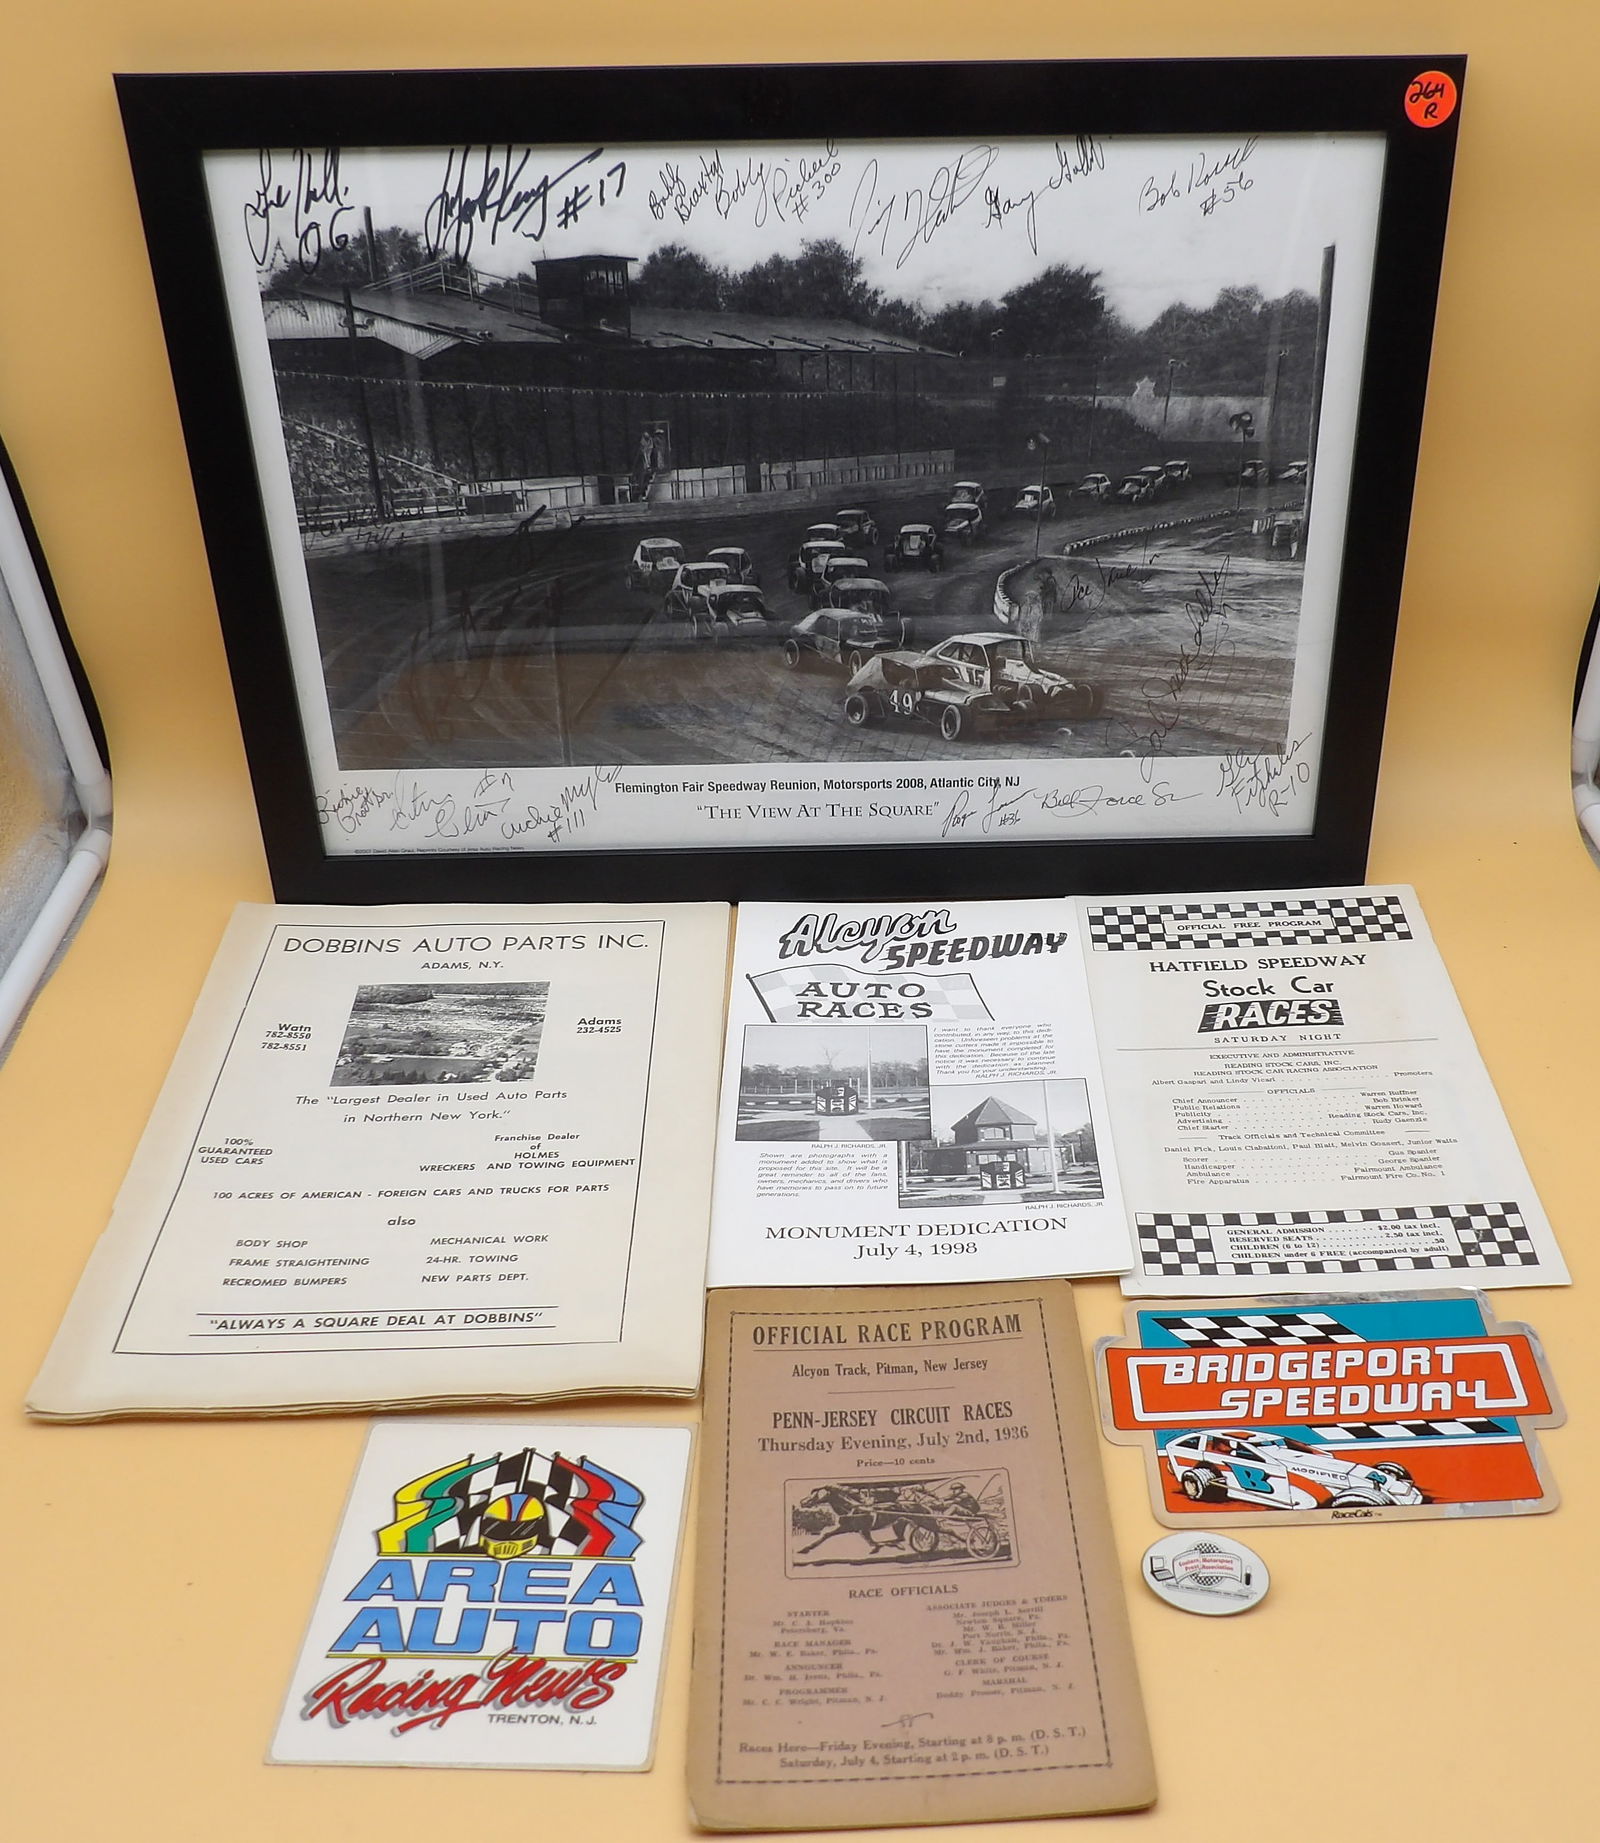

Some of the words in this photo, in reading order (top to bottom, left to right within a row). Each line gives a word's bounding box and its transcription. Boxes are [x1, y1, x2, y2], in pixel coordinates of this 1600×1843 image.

[1409, 80, 1445, 103] 264
[1424, 102, 1438, 119] R
[888, 688, 915, 715] 49
[616, 783, 678, 795] Flemington
[683, 782, 704, 792] Fair
[708, 781, 766, 793] Speedway
[771, 780, 819, 791] Reunion,
[824, 779, 892, 791] Motorsports
[896, 778, 926, 789] 2008,
[930, 777, 973, 788] Atlantic
[1006, 776, 1019, 786] NJ
[284, 938, 401, 953] DOBBINS
[413, 937, 491, 952] AUTO
[503, 936, 586, 950] PARTS
[599, 935, 647, 948] INC.
[778, 908, 959, 964] Alcyon
[878, 931, 1069, 972] SPEEDWAY
[421, 962, 471, 970] ADAMS,
[1150, 960, 1247, 972] HATFIELD
[1258, 954, 1366, 969] SPEEDWAY
[795, 981, 926, 999] AUTO
[1203, 978, 1275, 997] Stock
[1291, 976, 1333, 993] Car
[797, 1001, 935, 1020] RACES
[1213, 1000, 1334, 1031] RACES
[578, 1017, 621, 1025] Adams
[266, 1031, 311, 1039] 782-8550
[1215, 1036, 1286, 1046] SATURDAY
[262, 1042, 306, 1051] 782-8551
[296, 1096, 318, 1104] The
[388, 1094, 430, 1103] Dealer
[457, 1092, 488, 1101] Used
[364, 1113, 422, 1122] Northern
[431, 1112, 461, 1120] New
[198, 1147, 272, 1155] GUARANTEED
[572, 1159, 635, 1167] EQUIPMENT
[302, 1191, 362, 1199] AMERICAN
[576, 1184, 609, 1192] PARTS
[388, 1216, 415, 1225] also
[766, 1225, 910, 1239] MONUMENT
[918, 1218, 1066, 1236] DEDICATION
[430, 1237, 505, 1245] MECHANICAL
[854, 1243, 898, 1260] July
[905, 1244, 922, 1257] 4,
[931, 1243, 977, 1255] 1998
[276, 1258, 369, 1267] STRAIGHTENING
[294, 1277, 347, 1285] BUMPERS
[456, 1274, 491, 1282] PARTS
[293, 1319, 304, 1328] A
[314, 1317, 379, 1327] SQUARE
[387, 1315, 425, 1325] DEAL
[434, 1315, 456, 1324] AT
[753, 1325, 847, 1345] OFFICIAL
[858, 1323, 911, 1343] RACE
[921, 1314, 1022, 1345] PROGRAM
[792, 1364, 829, 1379] Alcyon
[835, 1363, 870, 1376] Track,
[877, 1362, 918, 1375] Pitman,
[924, 1360, 947, 1372] New
[953, 1358, 987, 1370] Jersey
[1163, 1346, 1454, 1386] BRIDGEPORT
[1220, 1380, 1486, 1419] SPEEDWAY
[773, 1410, 877, 1428] PENN-JERSEY
[891, 1406, 950, 1425] CIRCUIT
[963, 1401, 1012, 1421] RACES
[758, 1437, 834, 1453] Thursday
[841, 1435, 911, 1449] Evening,
[917, 1432, 949, 1448] July
[956, 1429, 989, 1444] 2nd,
[995, 1426, 1028, 1441] 1936
[1222, 1462, 1275, 1494] B
[1290, 1465, 1348, 1482] MODIFIED
[343, 1559, 644, 1606] AREA
[849, 1588, 883, 1599] RACE
[891, 1584, 958, 1596] OFFICIALS
[327, 1606, 643, 1657] AUTO
[300, 1657, 482, 1737] Racing
[480, 1646, 628, 1713] News
[488, 1714, 563, 1725] TRENTON,
